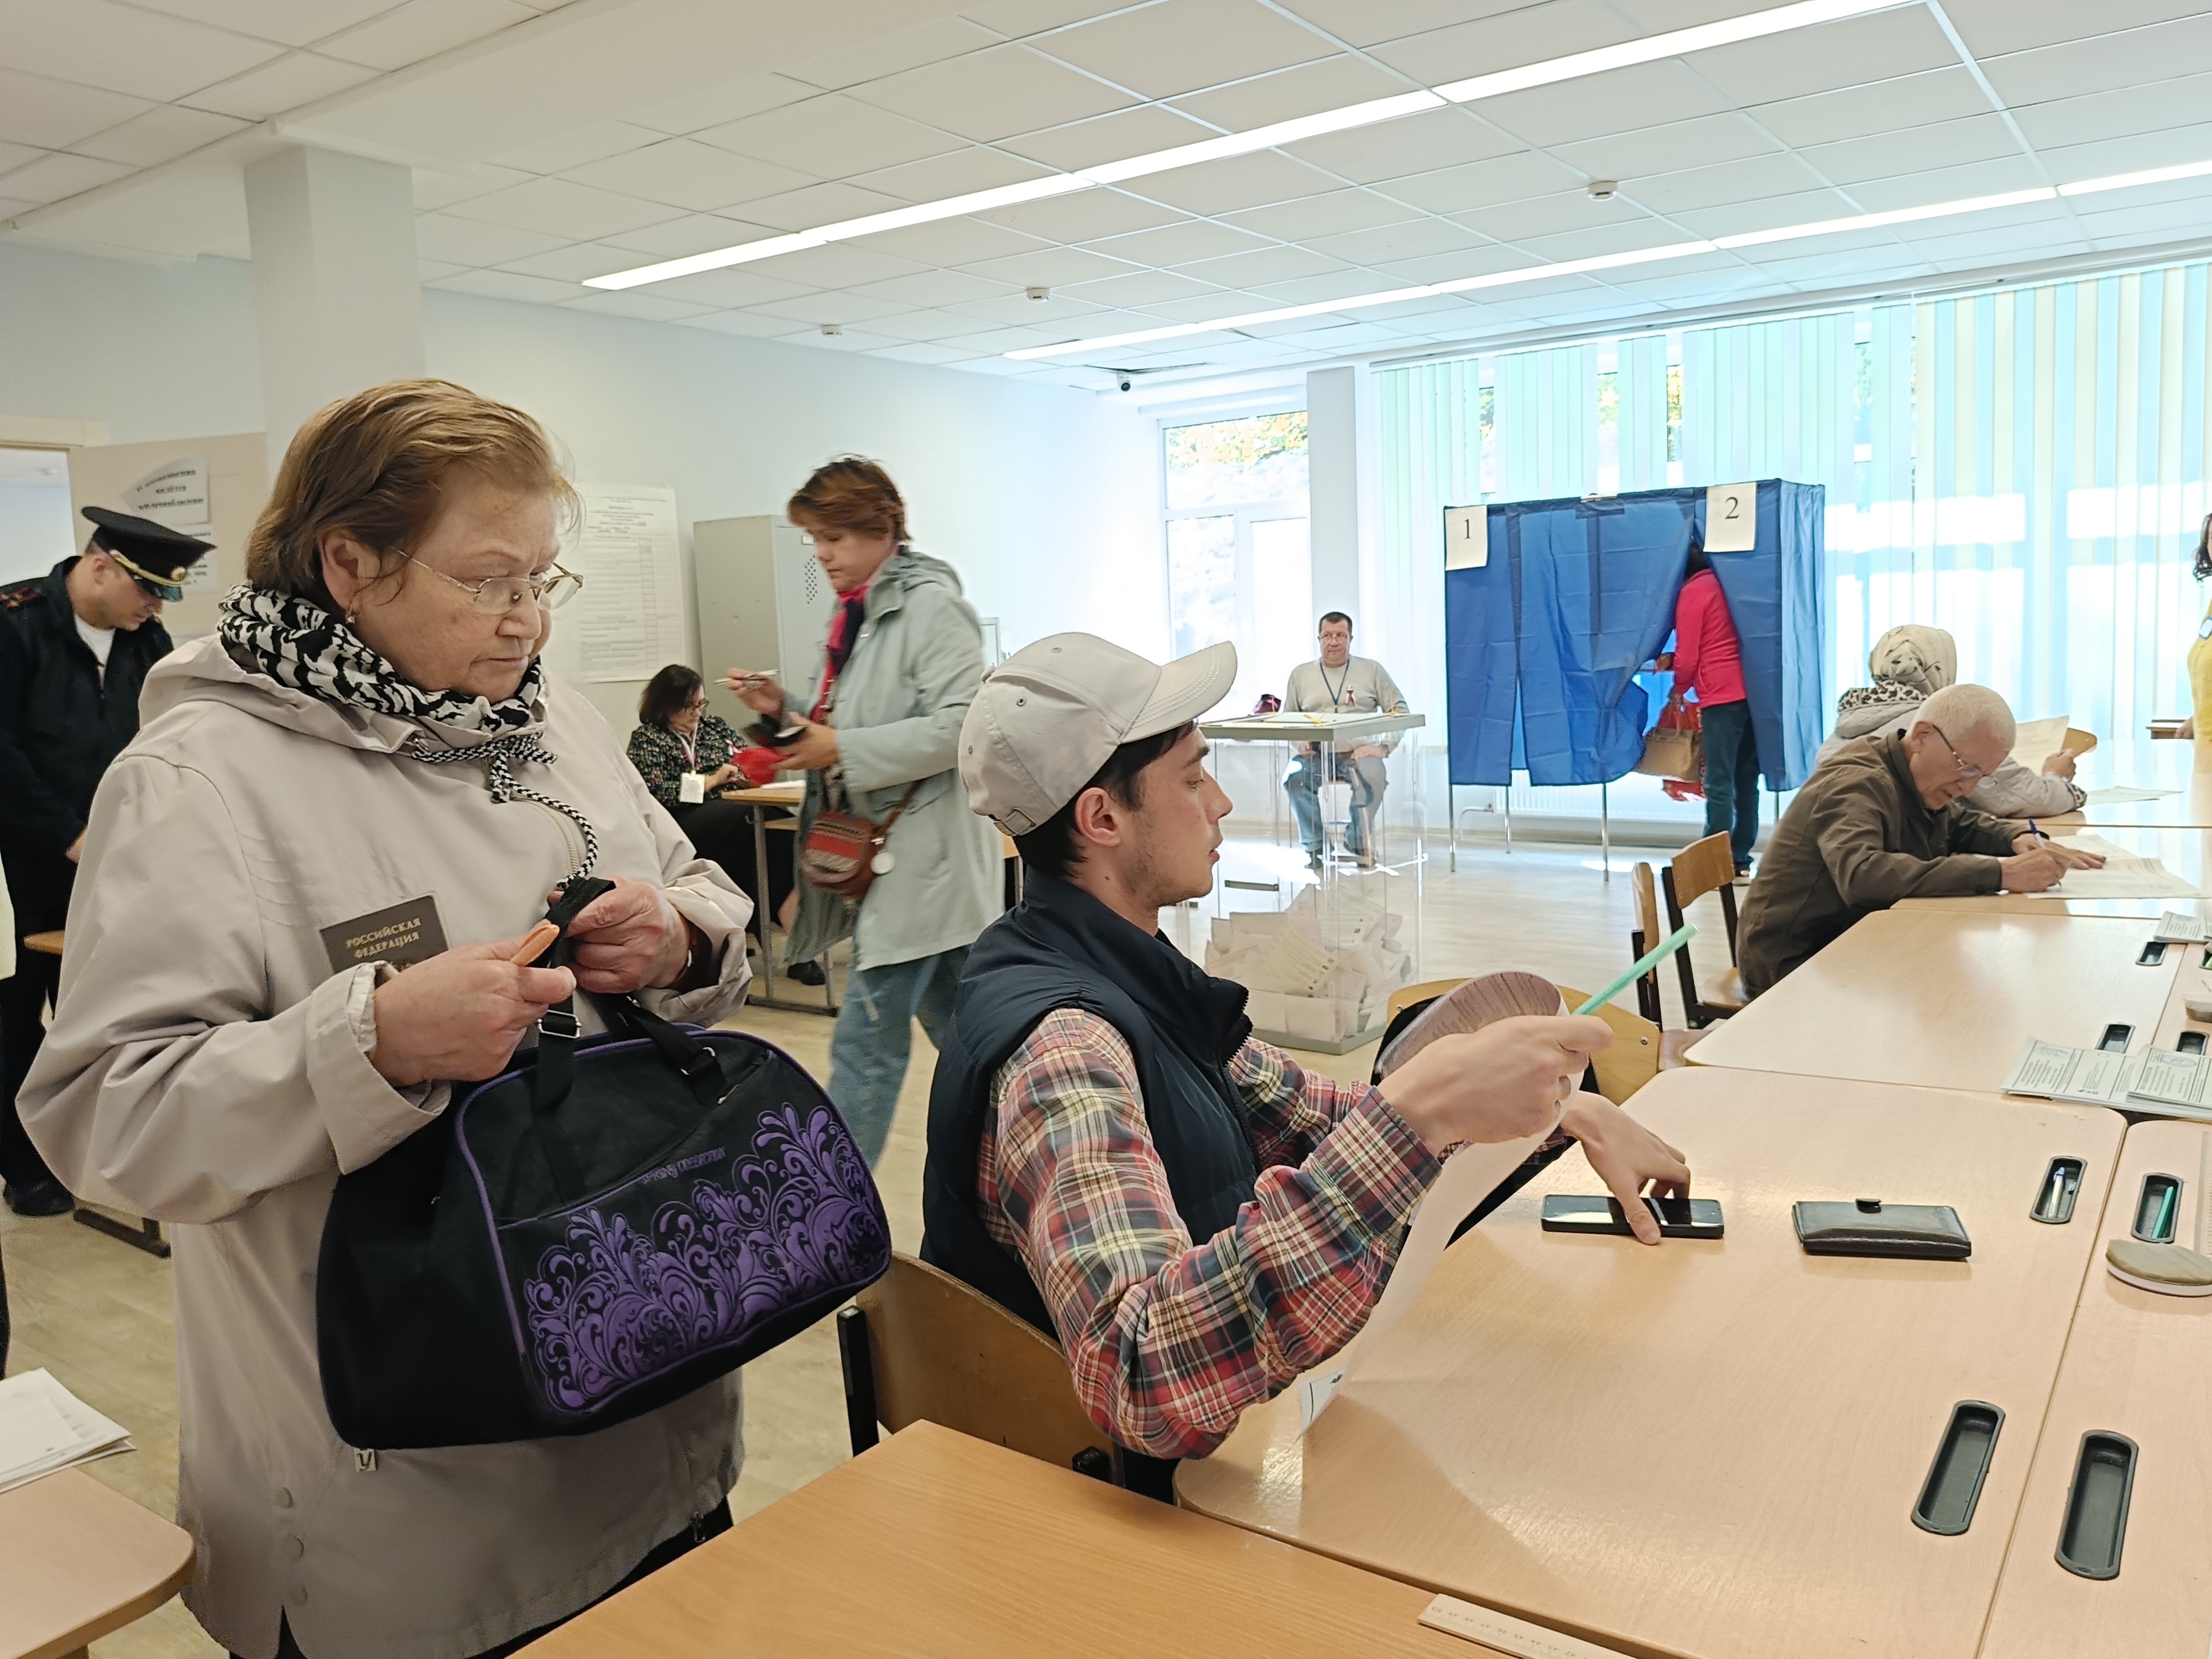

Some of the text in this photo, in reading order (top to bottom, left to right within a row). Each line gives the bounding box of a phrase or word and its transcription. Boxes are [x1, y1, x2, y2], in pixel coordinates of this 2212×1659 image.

[1724, 496, 1740, 520] 2
[1464, 518, 1472, 540] 1
[345, 917, 421, 950] РОССИЙСКАЯ
[354, 931, 420, 959] ФЕДЕРАЦИЯ
